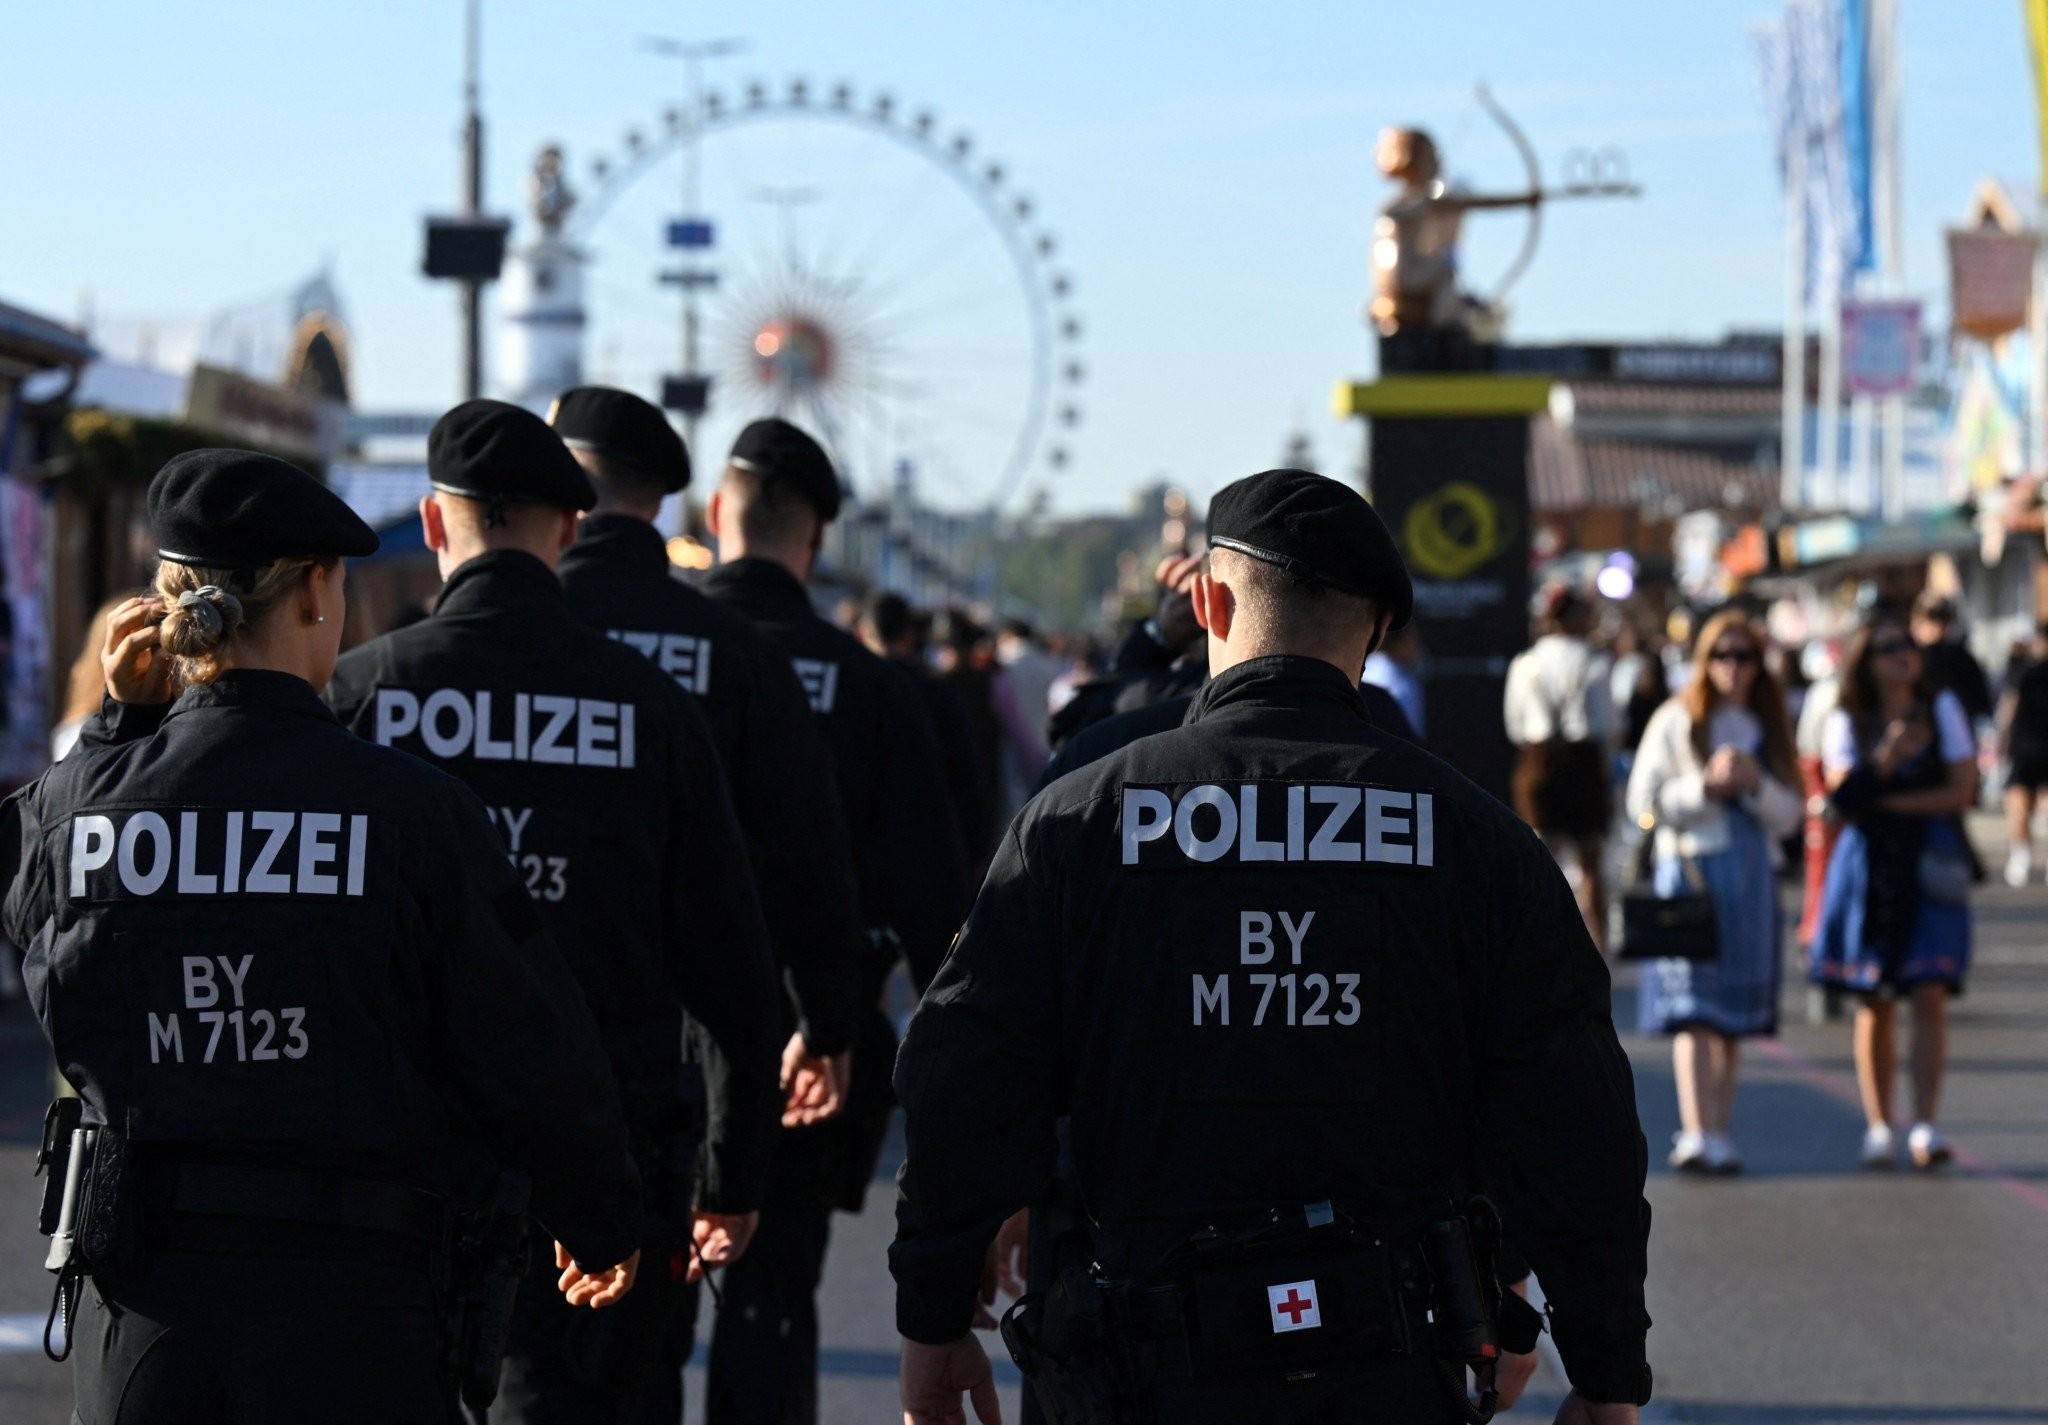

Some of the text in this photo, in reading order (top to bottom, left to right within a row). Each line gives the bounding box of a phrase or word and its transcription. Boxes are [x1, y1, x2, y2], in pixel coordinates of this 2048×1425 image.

[376, 688, 635, 768] POLIZEI
[486, 807, 533, 852] Y
[1122, 785, 1434, 867] POLIZEI
[70, 811, 368, 897] POLIZEI
[508, 854, 568, 901] 23
[1240, 911, 1316, 965] BY
[183, 955, 254, 1009] BY
[1192, 973, 1361, 1026] M 7123
[148, 1007, 309, 1063] M 7123
